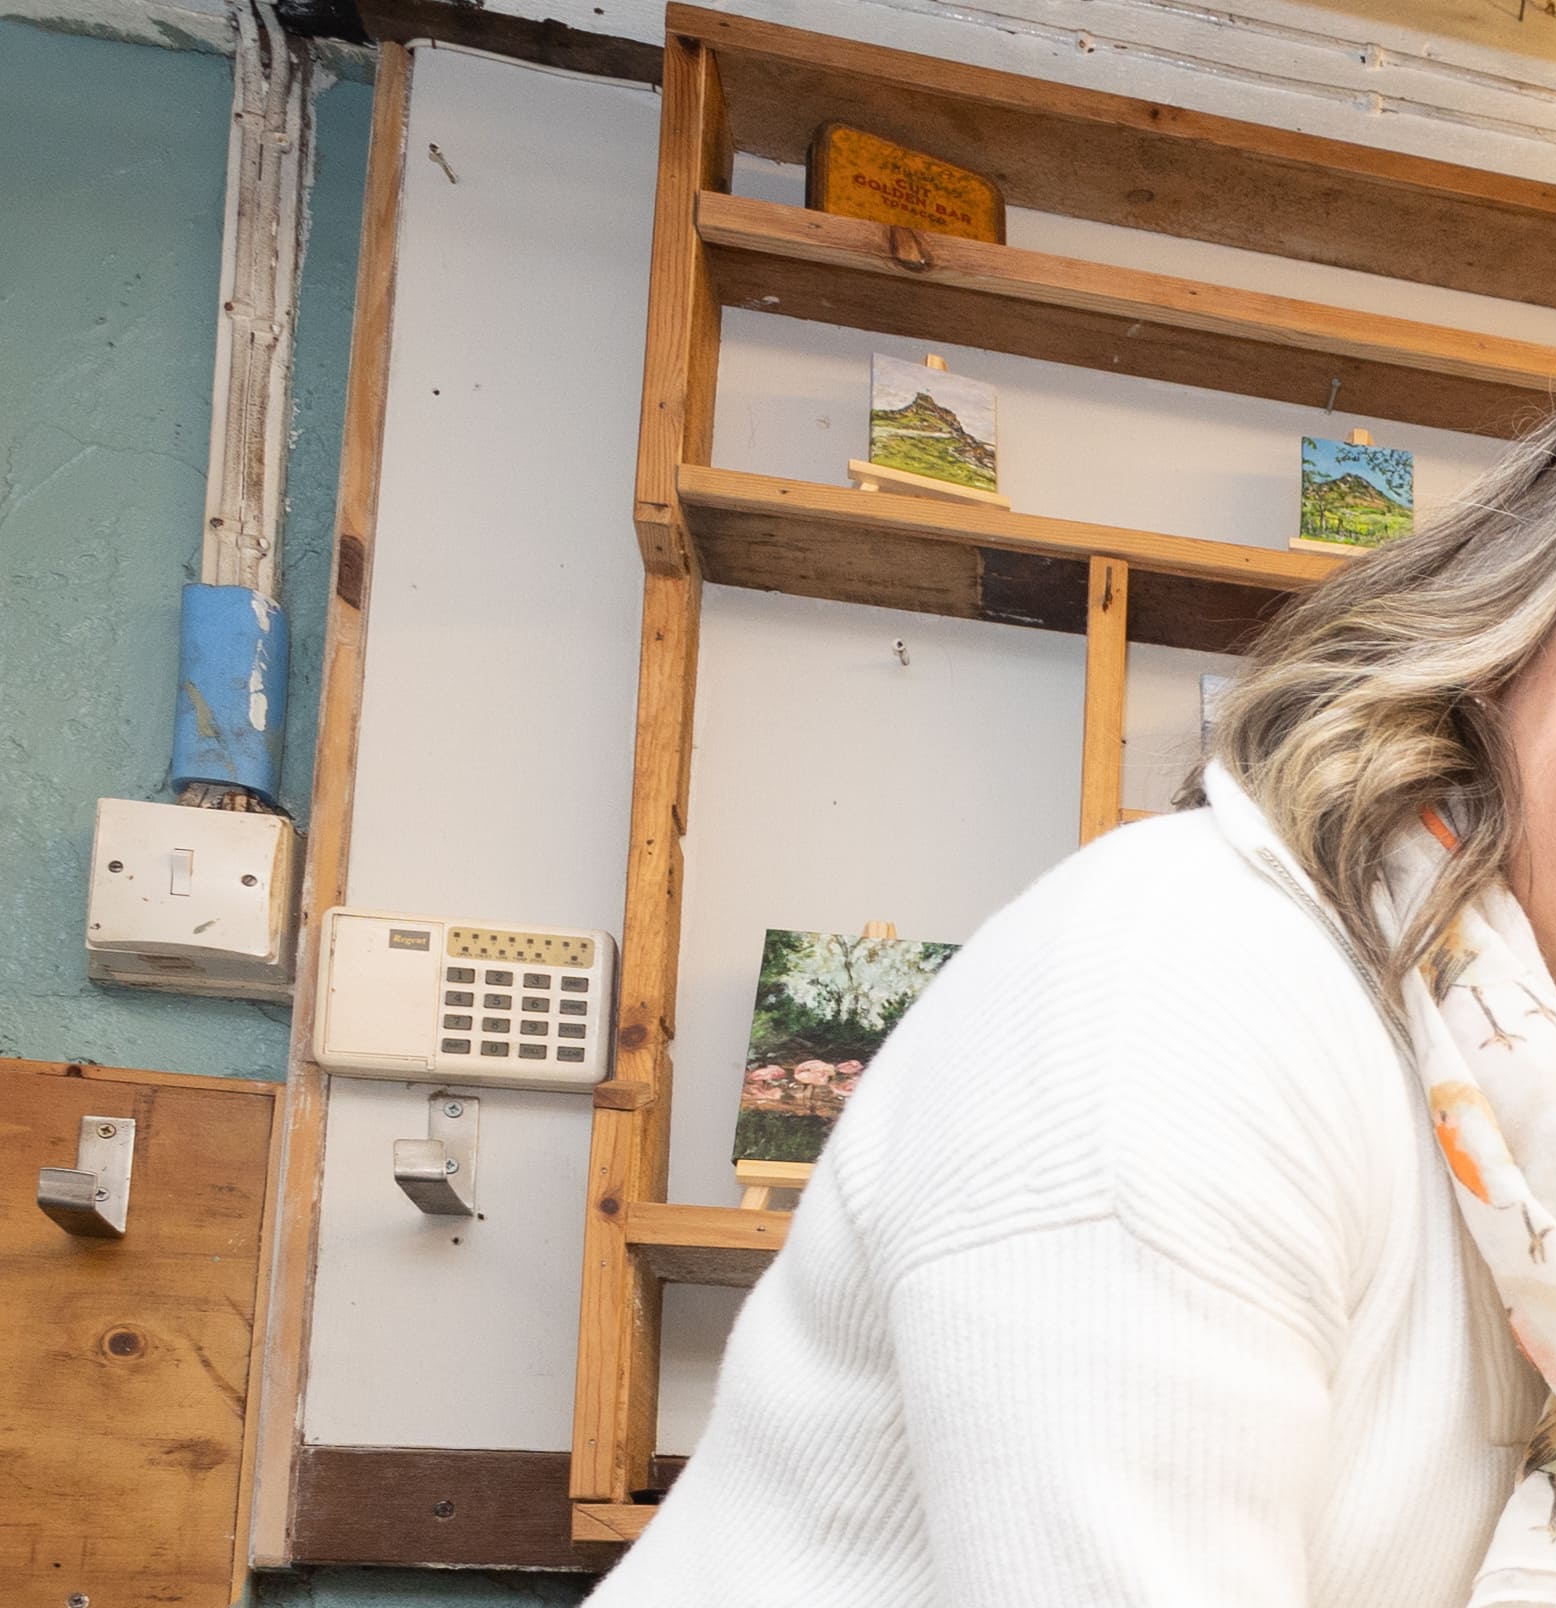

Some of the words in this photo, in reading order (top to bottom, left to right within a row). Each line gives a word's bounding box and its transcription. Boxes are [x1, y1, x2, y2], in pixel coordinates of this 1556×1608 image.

[895, 178, 931, 199] CUT
[853, 174, 928, 210] GOLDEN
[935, 203, 972, 225] BAR
[881, 196, 948, 225] TOBACCO
[456, 970, 463, 980] 1
[495, 973, 503, 982] 2
[531, 975, 540, 986] 3
[454, 994, 462, 1003] 4
[492, 996, 501, 1006] 5
[531, 999, 539, 1009] 6
[529, 1022, 537, 1032] 9
